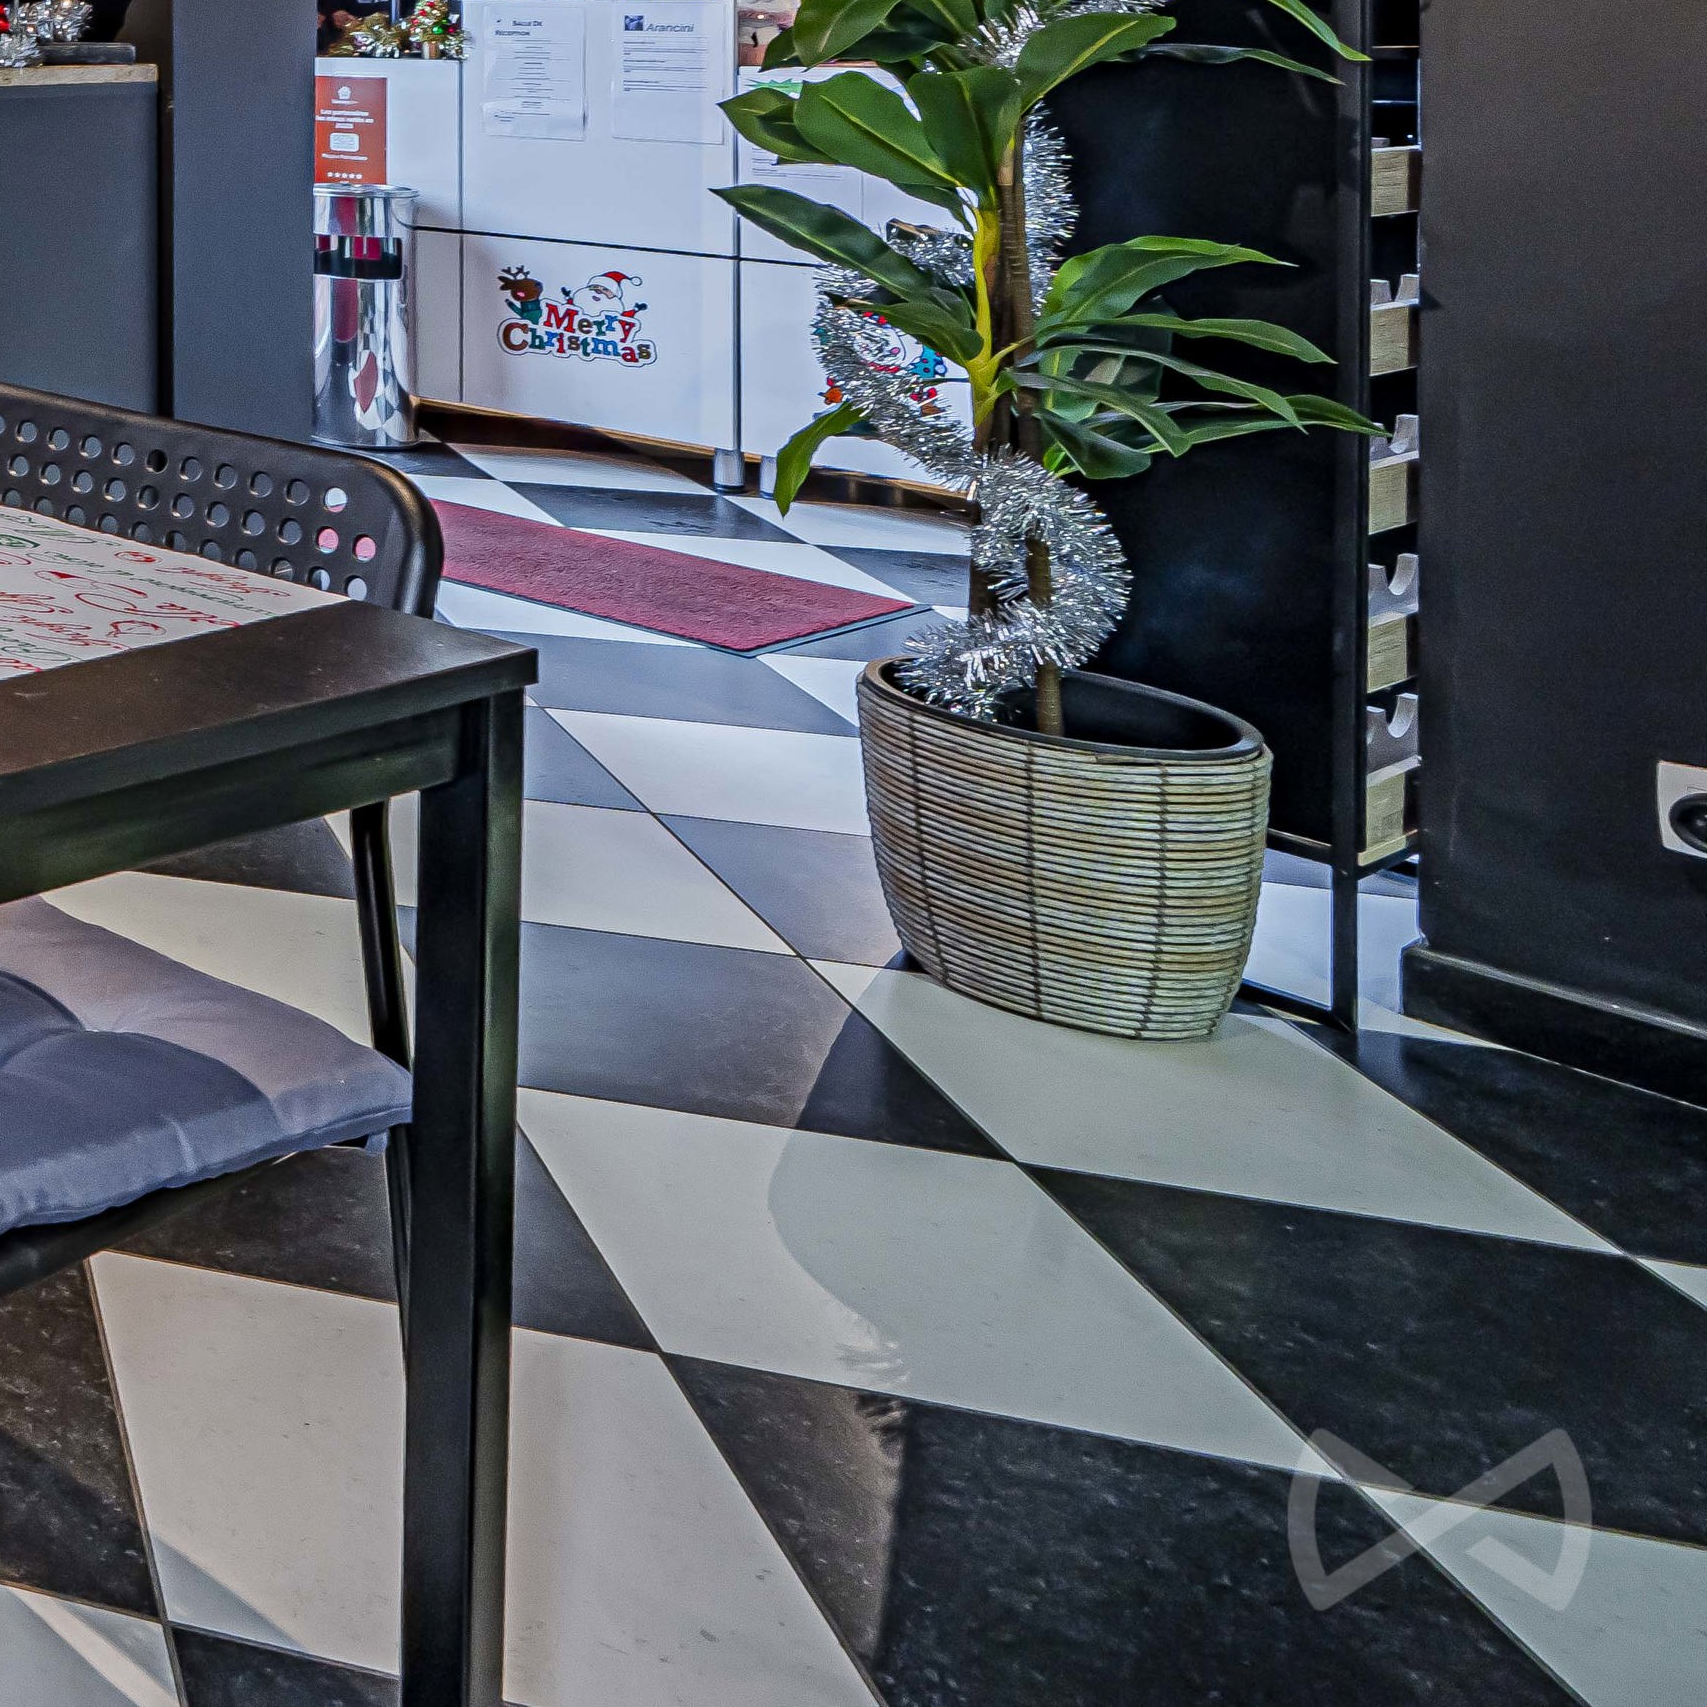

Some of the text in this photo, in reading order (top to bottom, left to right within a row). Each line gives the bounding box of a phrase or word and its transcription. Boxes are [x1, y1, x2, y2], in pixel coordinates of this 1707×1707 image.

[645, 22, 696, 33] Arancini
[501, 321, 652, 363] Christmas
[543, 302, 637, 343] Merry
